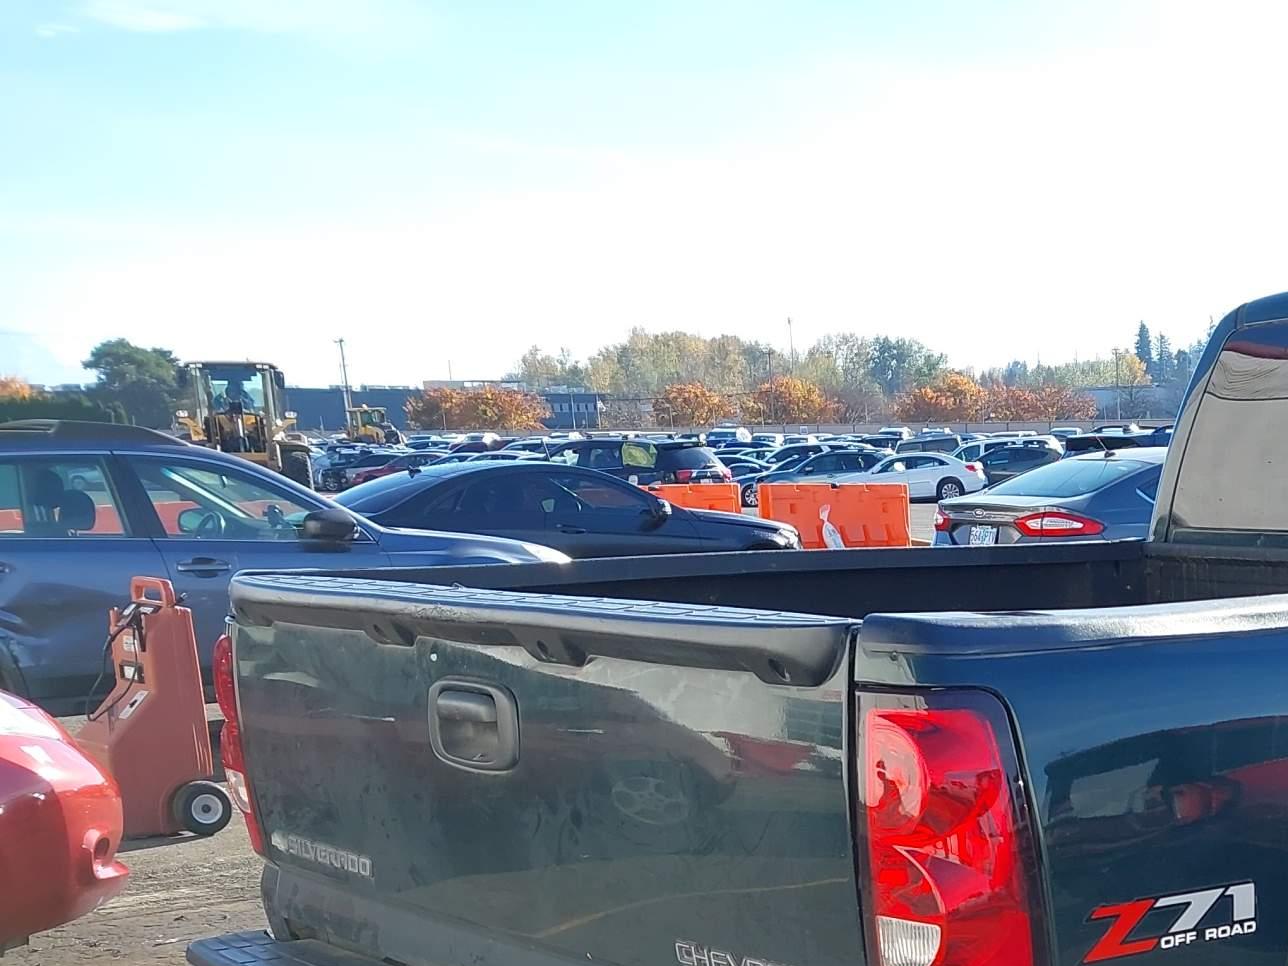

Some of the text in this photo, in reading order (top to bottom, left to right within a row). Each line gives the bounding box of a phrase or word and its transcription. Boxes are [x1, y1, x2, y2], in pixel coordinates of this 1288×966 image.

[286, 836, 371, 876] SILVERADO
[1081, 881, 1257, 964] Z71
[1160, 921, 1257, 950] OFF ROAD
